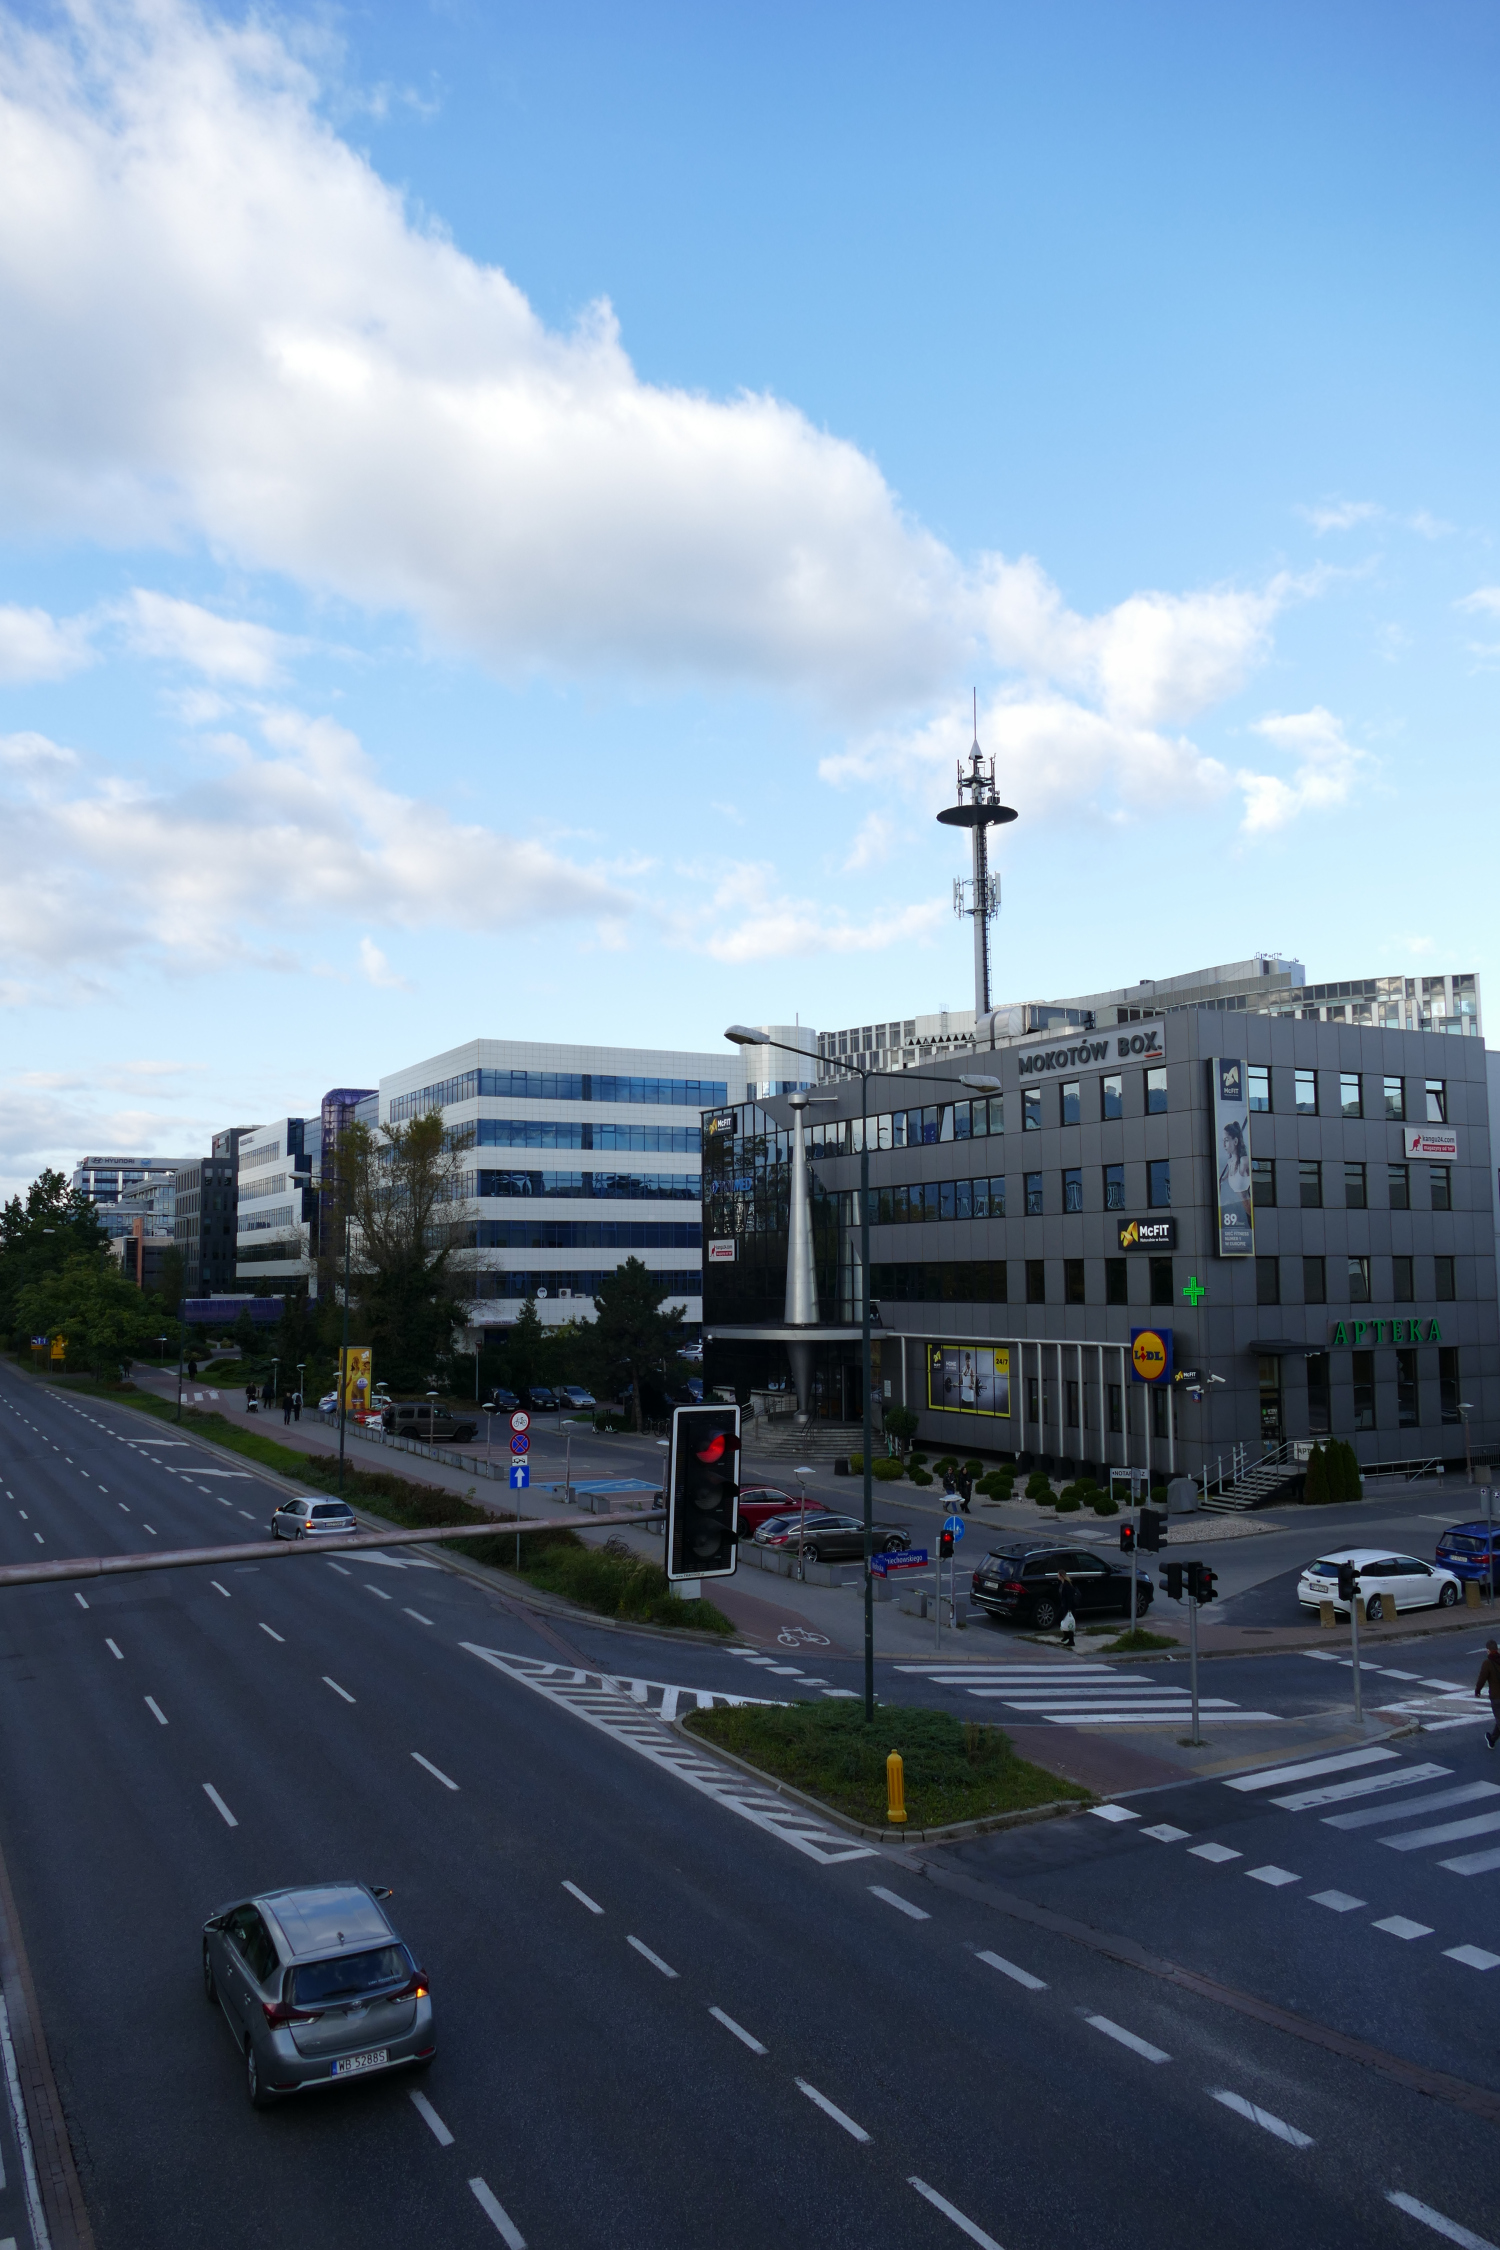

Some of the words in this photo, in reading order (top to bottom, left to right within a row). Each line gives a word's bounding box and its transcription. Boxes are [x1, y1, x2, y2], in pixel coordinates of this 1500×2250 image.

[1019, 1039, 1109, 1075] MOKOTÓW
[718, 1118, 732, 1128] McFIT
[1422, 1135, 1455, 1144] kangu24.com
[1224, 1214, 1238, 1226] 89
[1139, 1224, 1170, 1237] McFIT
[1334, 1318, 1442, 1344] APTEKA
[996, 1358, 1008, 1366] 24/7
[339, 2059, 352, 2071] WB
[355, 2052, 384, 2068] 5288S
